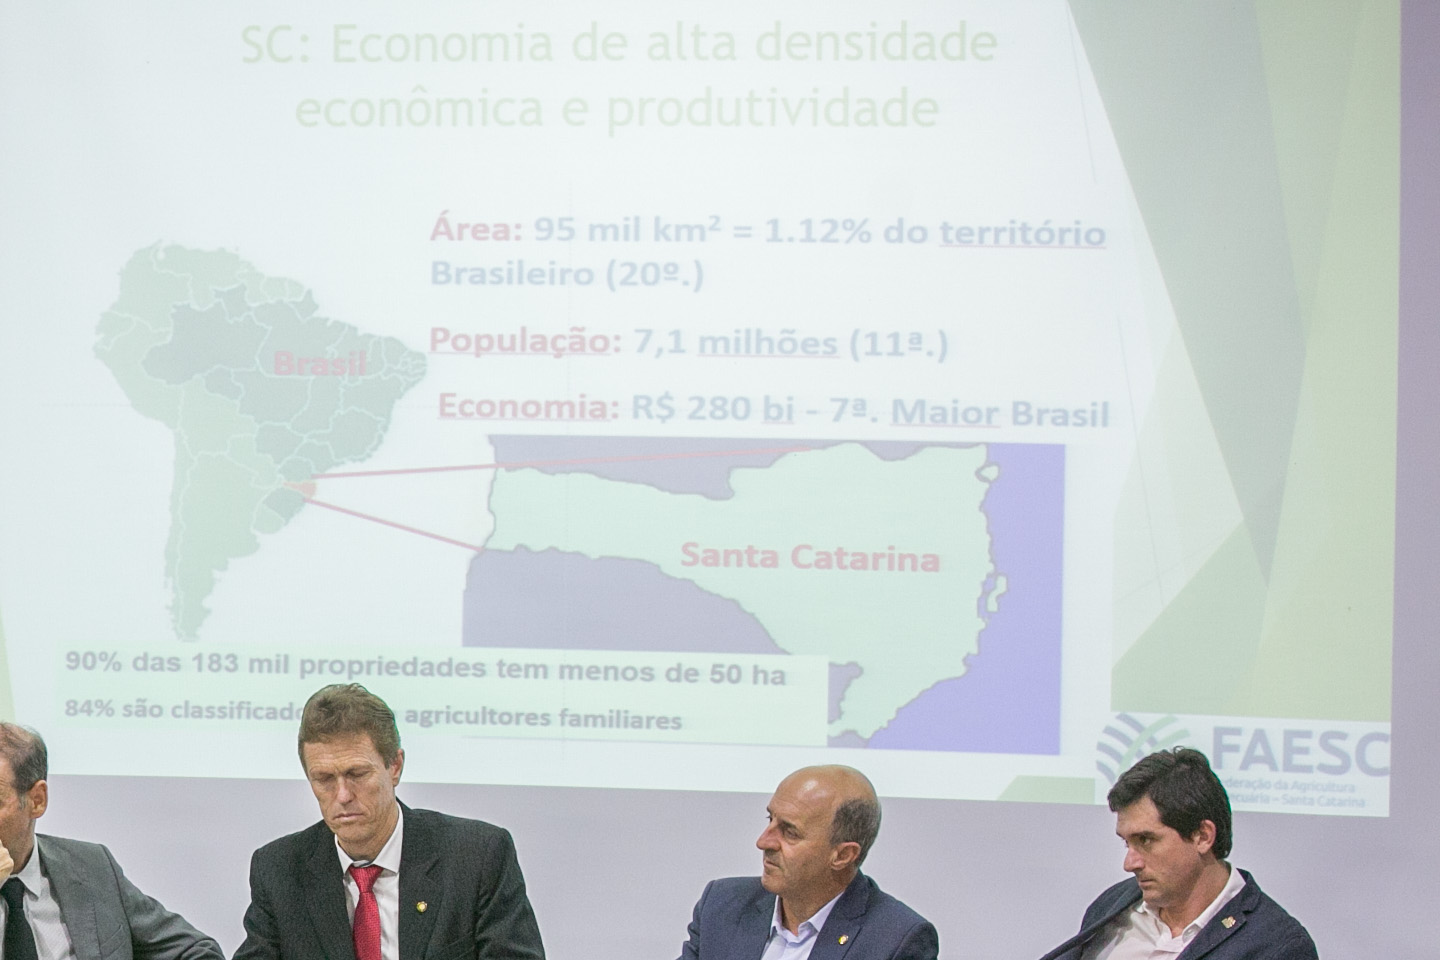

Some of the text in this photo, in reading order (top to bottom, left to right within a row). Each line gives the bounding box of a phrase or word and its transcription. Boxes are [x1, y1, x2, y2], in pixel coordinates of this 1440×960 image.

[241, 20, 998, 64] SC: Economia de alta densidade
[294, 86, 940, 137] econômica e produtividade
[430, 210, 522, 242] Área:
[534, 217, 575, 241] 95
[588, 215, 640, 242] mil
[654, 215, 722, 242] km²
[766, 218, 872, 243] 1.12%
[883, 218, 928, 243] do
[939, 219, 1106, 246] território
[431, 260, 594, 286] Brasileiro
[429, 326, 621, 358] População:
[634, 328, 686, 359] 7,1
[697, 328, 839, 357] milhões
[274, 350, 368, 376] Brasil
[438, 393, 619, 421] Economia:
[632, 391, 676, 423] R$
[687, 396, 751, 421] 280
[763, 395, 794, 424] bi
[891, 398, 1000, 427] Maior
[1012, 401, 1109, 428] Brasil
[681, 541, 940, 572] Santa Catarina
[65, 651, 787, 686] 90% das 183 mil propriedades tem menos de 50 ha
[65, 699, 115, 717] 84%
[122, 698, 163, 718] são
[405, 706, 551, 729] agricultores
[559, 708, 682, 731] familiares
[1213, 726, 1391, 777] FAESC
